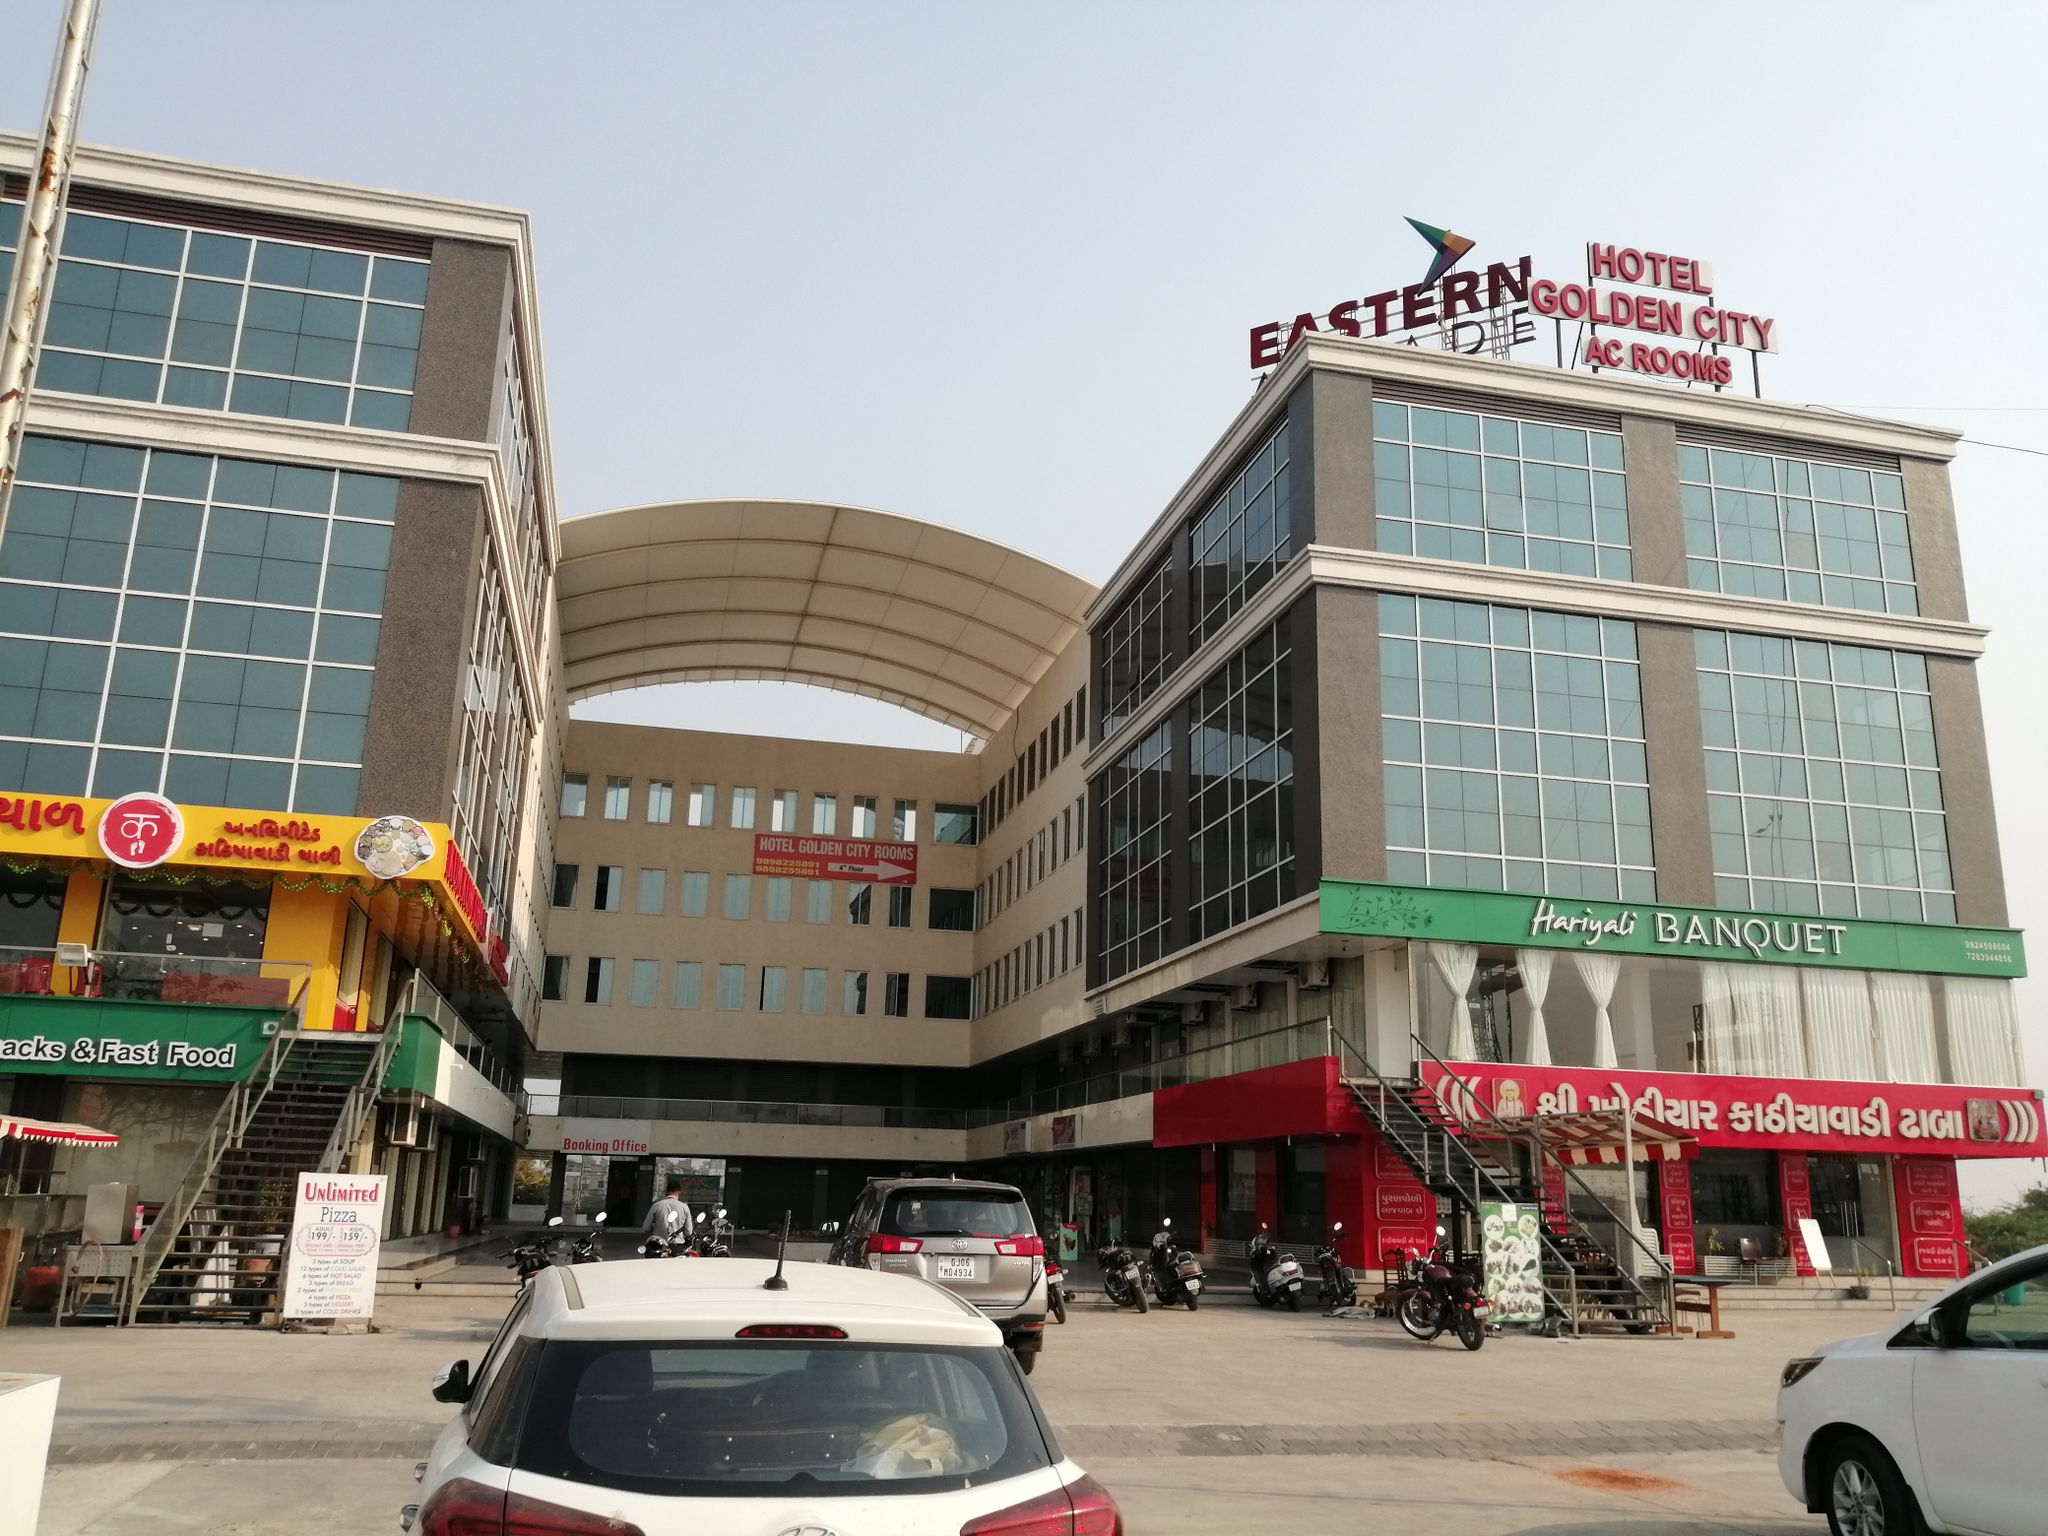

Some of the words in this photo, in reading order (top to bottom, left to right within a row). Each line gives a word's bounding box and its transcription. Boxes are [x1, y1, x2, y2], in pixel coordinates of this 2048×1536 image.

[1592, 242, 1713, 296] HOTEL
[1250, 255, 1531, 369] EASTERN
[1531, 279, 1683, 336] GOLDEN
[1693, 305, 1774, 350] CITY
[1585, 336, 1624, 367] AC
[1631, 343, 1733, 384] ROOMS
[297, 845, 341, 866] થાળી
[760, 837, 795, 853] HOTEL
[799, 839, 843, 857] GOLDEN
[846, 843, 871, 859] CITY
[874, 845, 914, 861] ROOMS
[1529, 898, 1639, 946] Hariyali
[1652, 912, 1847, 958] BANQUET
[72, 1038, 96, 1062] &
[99, 1039, 158, 1064] Fast
[167, 1042, 236, 1067] Food
[1727, 1092, 1891, 1137] કાઠીયાવાડી
[1898, 1108, 1965, 1139] ઢાબા
[563, 1137, 609, 1154] Booking
[611, 1138, 647, 1152] Office
[320, 1206, 357, 1223] Pizza
[951, 1258, 970, 1267] GJ06
